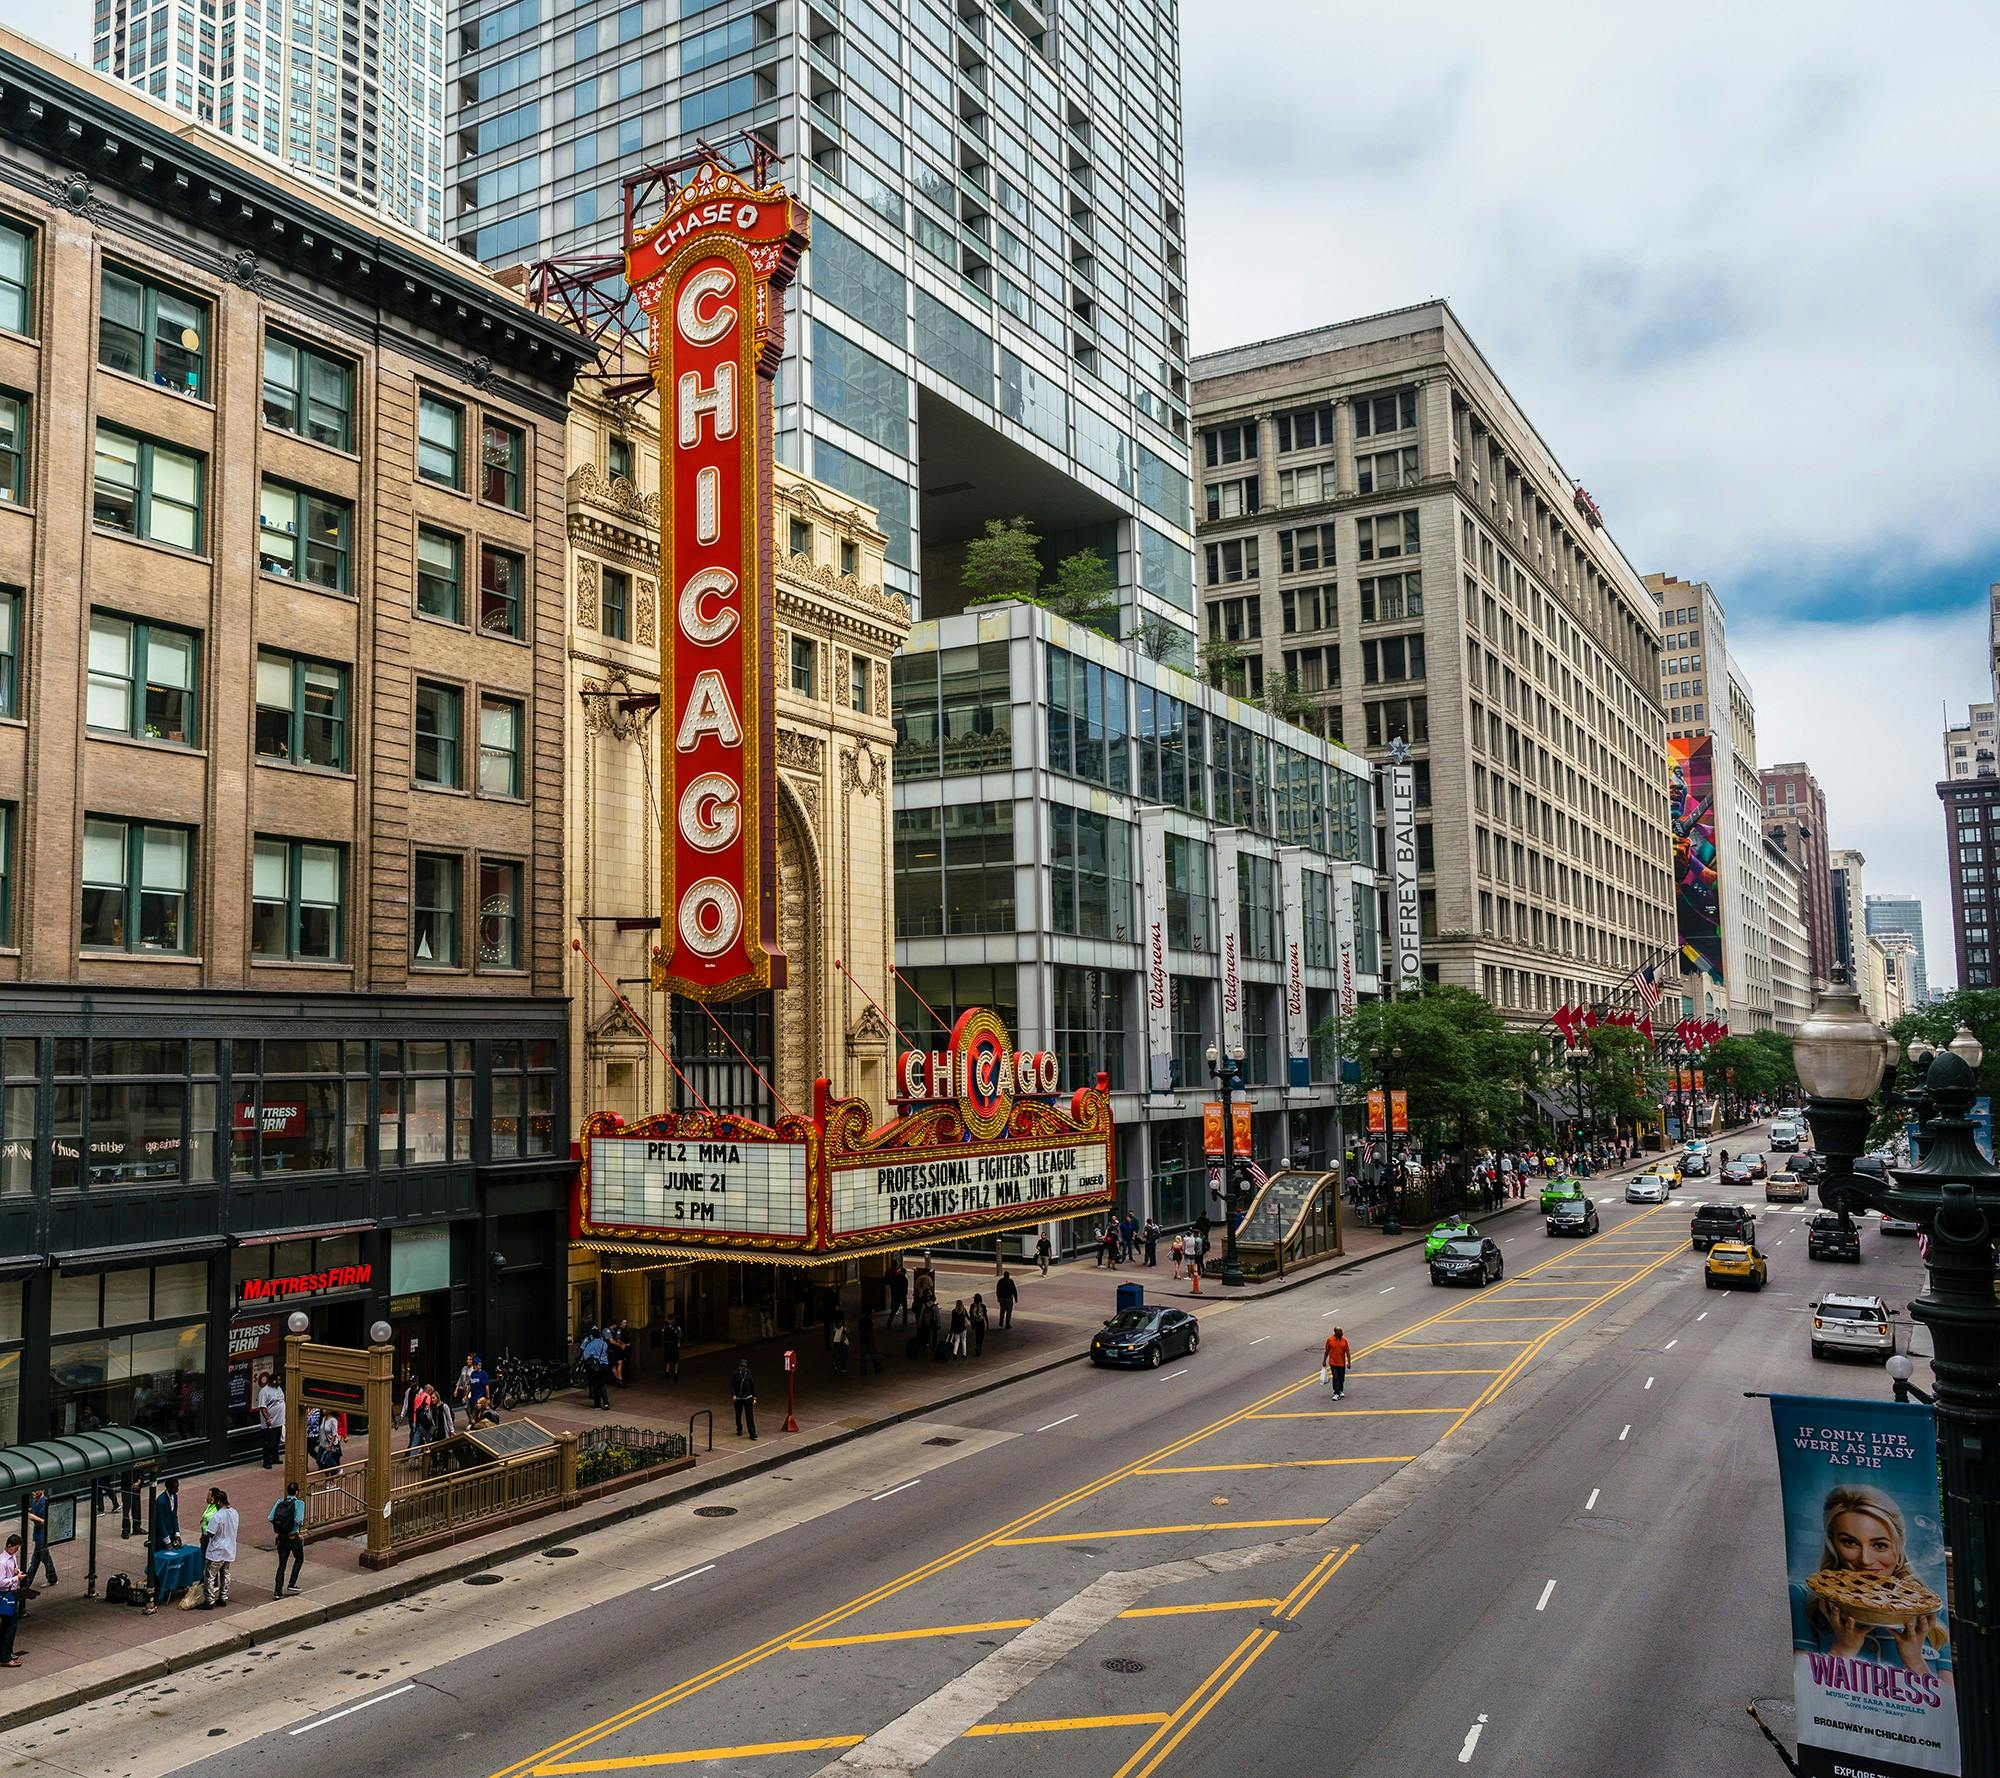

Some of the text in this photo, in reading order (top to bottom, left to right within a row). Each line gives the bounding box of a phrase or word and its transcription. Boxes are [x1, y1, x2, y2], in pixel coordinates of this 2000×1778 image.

[654, 203, 734, 256] CHASE
[676, 267, 744, 959] CHICAGO
[1394, 768, 1415, 862] BALLET
[1149, 921, 1168, 1011] Walgreens
[1224, 932, 1240, 1014] Walgreens
[1287, 942, 1304, 1017] Walgreens
[1340, 951, 1356, 1017] Walgreens
[903, 1049, 1059, 1099] CHICAGO
[244, 1106, 297, 1119] MTTRESS
[647, 1142, 740, 1164] PFL2 MMA
[877, 1148, 1077, 1194] PROFESSIONAL FIGHTERS LEAGUE
[664, 1172, 726, 1193] JUNE 21
[962, 1184, 990, 1211] PFL2
[996, 1182, 1021, 1203] MMA
[1027, 1177, 1054, 1201] JUNE
[1059, 1174, 1069, 1196] 21
[674, 1201, 715, 1222] 5 PM
[229, 1336, 260, 1353] FIRM
[1793, 1438, 1915, 1459] WERE AS EASY
[1799, 1426, 1908, 1446] IF ONLY LIFE
[1828, 1453, 1882, 1468] AS PIE
[1807, 1651, 1942, 1708] WAITRESS
[1825, 1690, 1849, 1700] MUSIC
[1863, 1697, 1884, 1707] SARA
[1885, 1701, 1926, 1715] BAREILLES
